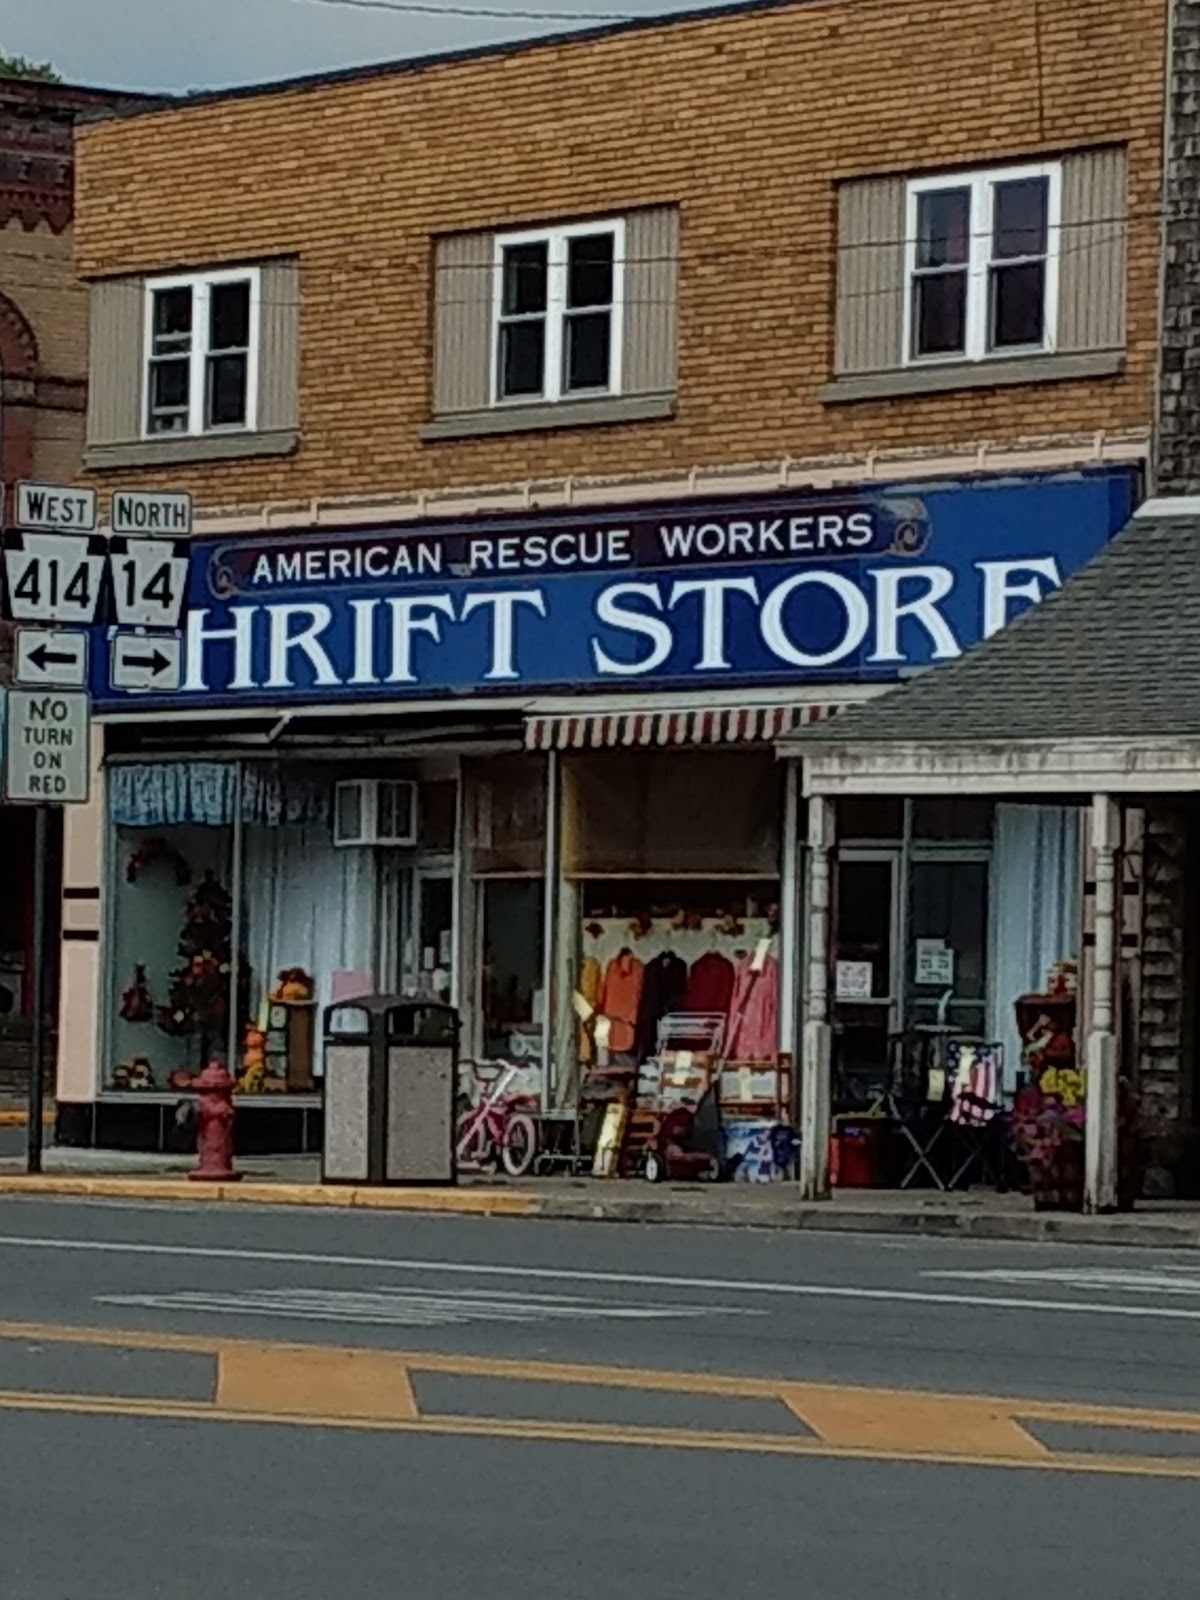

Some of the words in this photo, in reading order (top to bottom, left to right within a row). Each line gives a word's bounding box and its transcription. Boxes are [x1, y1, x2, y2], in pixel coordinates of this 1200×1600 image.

[27, 491, 88, 523] WEST
[117, 496, 187, 527] NORTH
[253, 543, 442, 584] AMERICAN
[470, 530, 631, 570] RESCUE
[660, 512, 874, 558] WORKERS
[14, 557, 91, 609] 414
[122, 560, 173, 609] 14
[107, 589, 547, 692] HRIFT
[29, 700, 68, 722] NO
[24, 726, 73, 746] TURN
[33, 751, 62, 770] ON
[29, 775, 66, 795] RED
